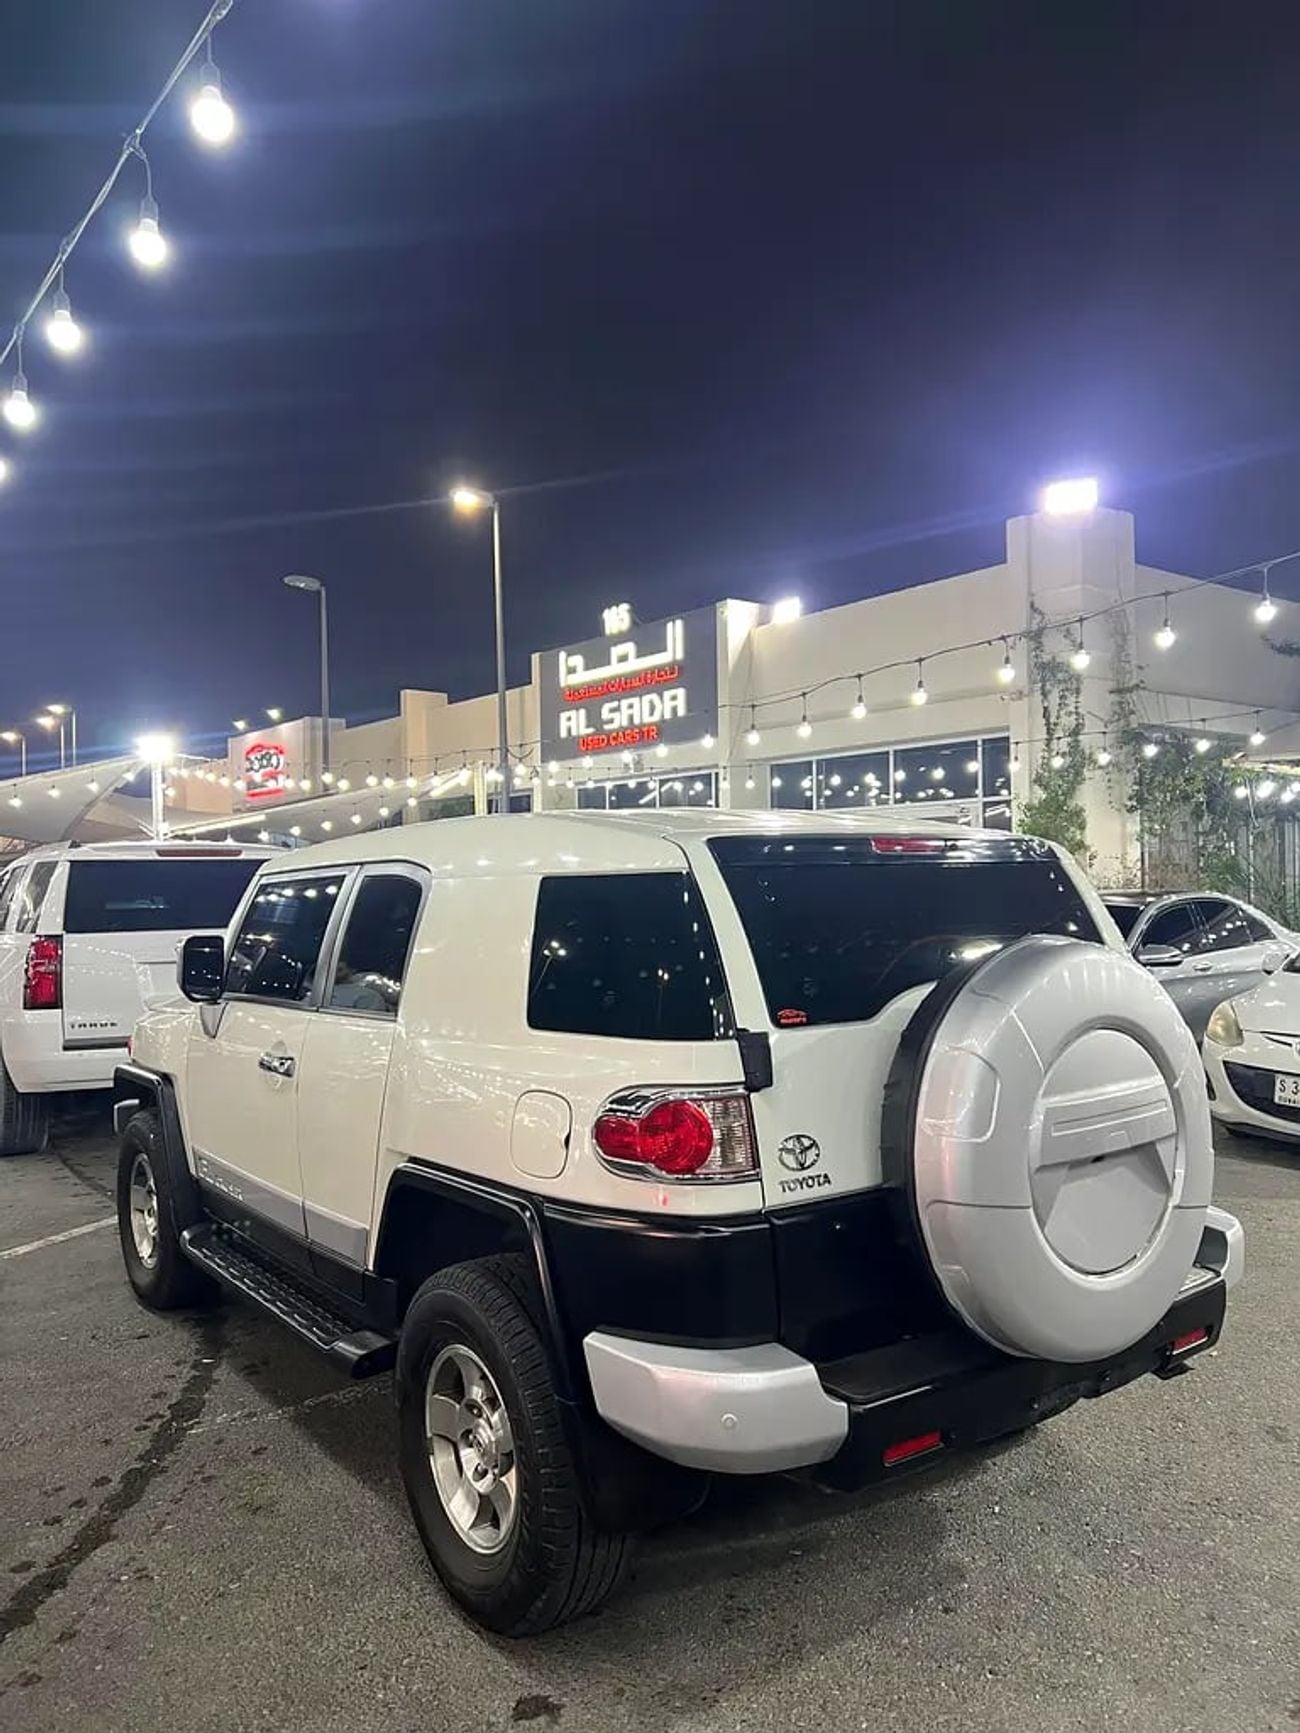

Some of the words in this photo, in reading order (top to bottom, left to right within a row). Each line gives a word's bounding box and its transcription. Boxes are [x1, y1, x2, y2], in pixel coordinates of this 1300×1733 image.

[559, 708, 596, 738] AL
[601, 687, 687, 730] SADA
[580, 735, 607, 751] USED
[610, 729, 640, 746] CARS
[643, 725, 658, 740] TR
[1279, 1079, 1286, 1093] S
[778, 1173, 831, 1192] TOYOTA
